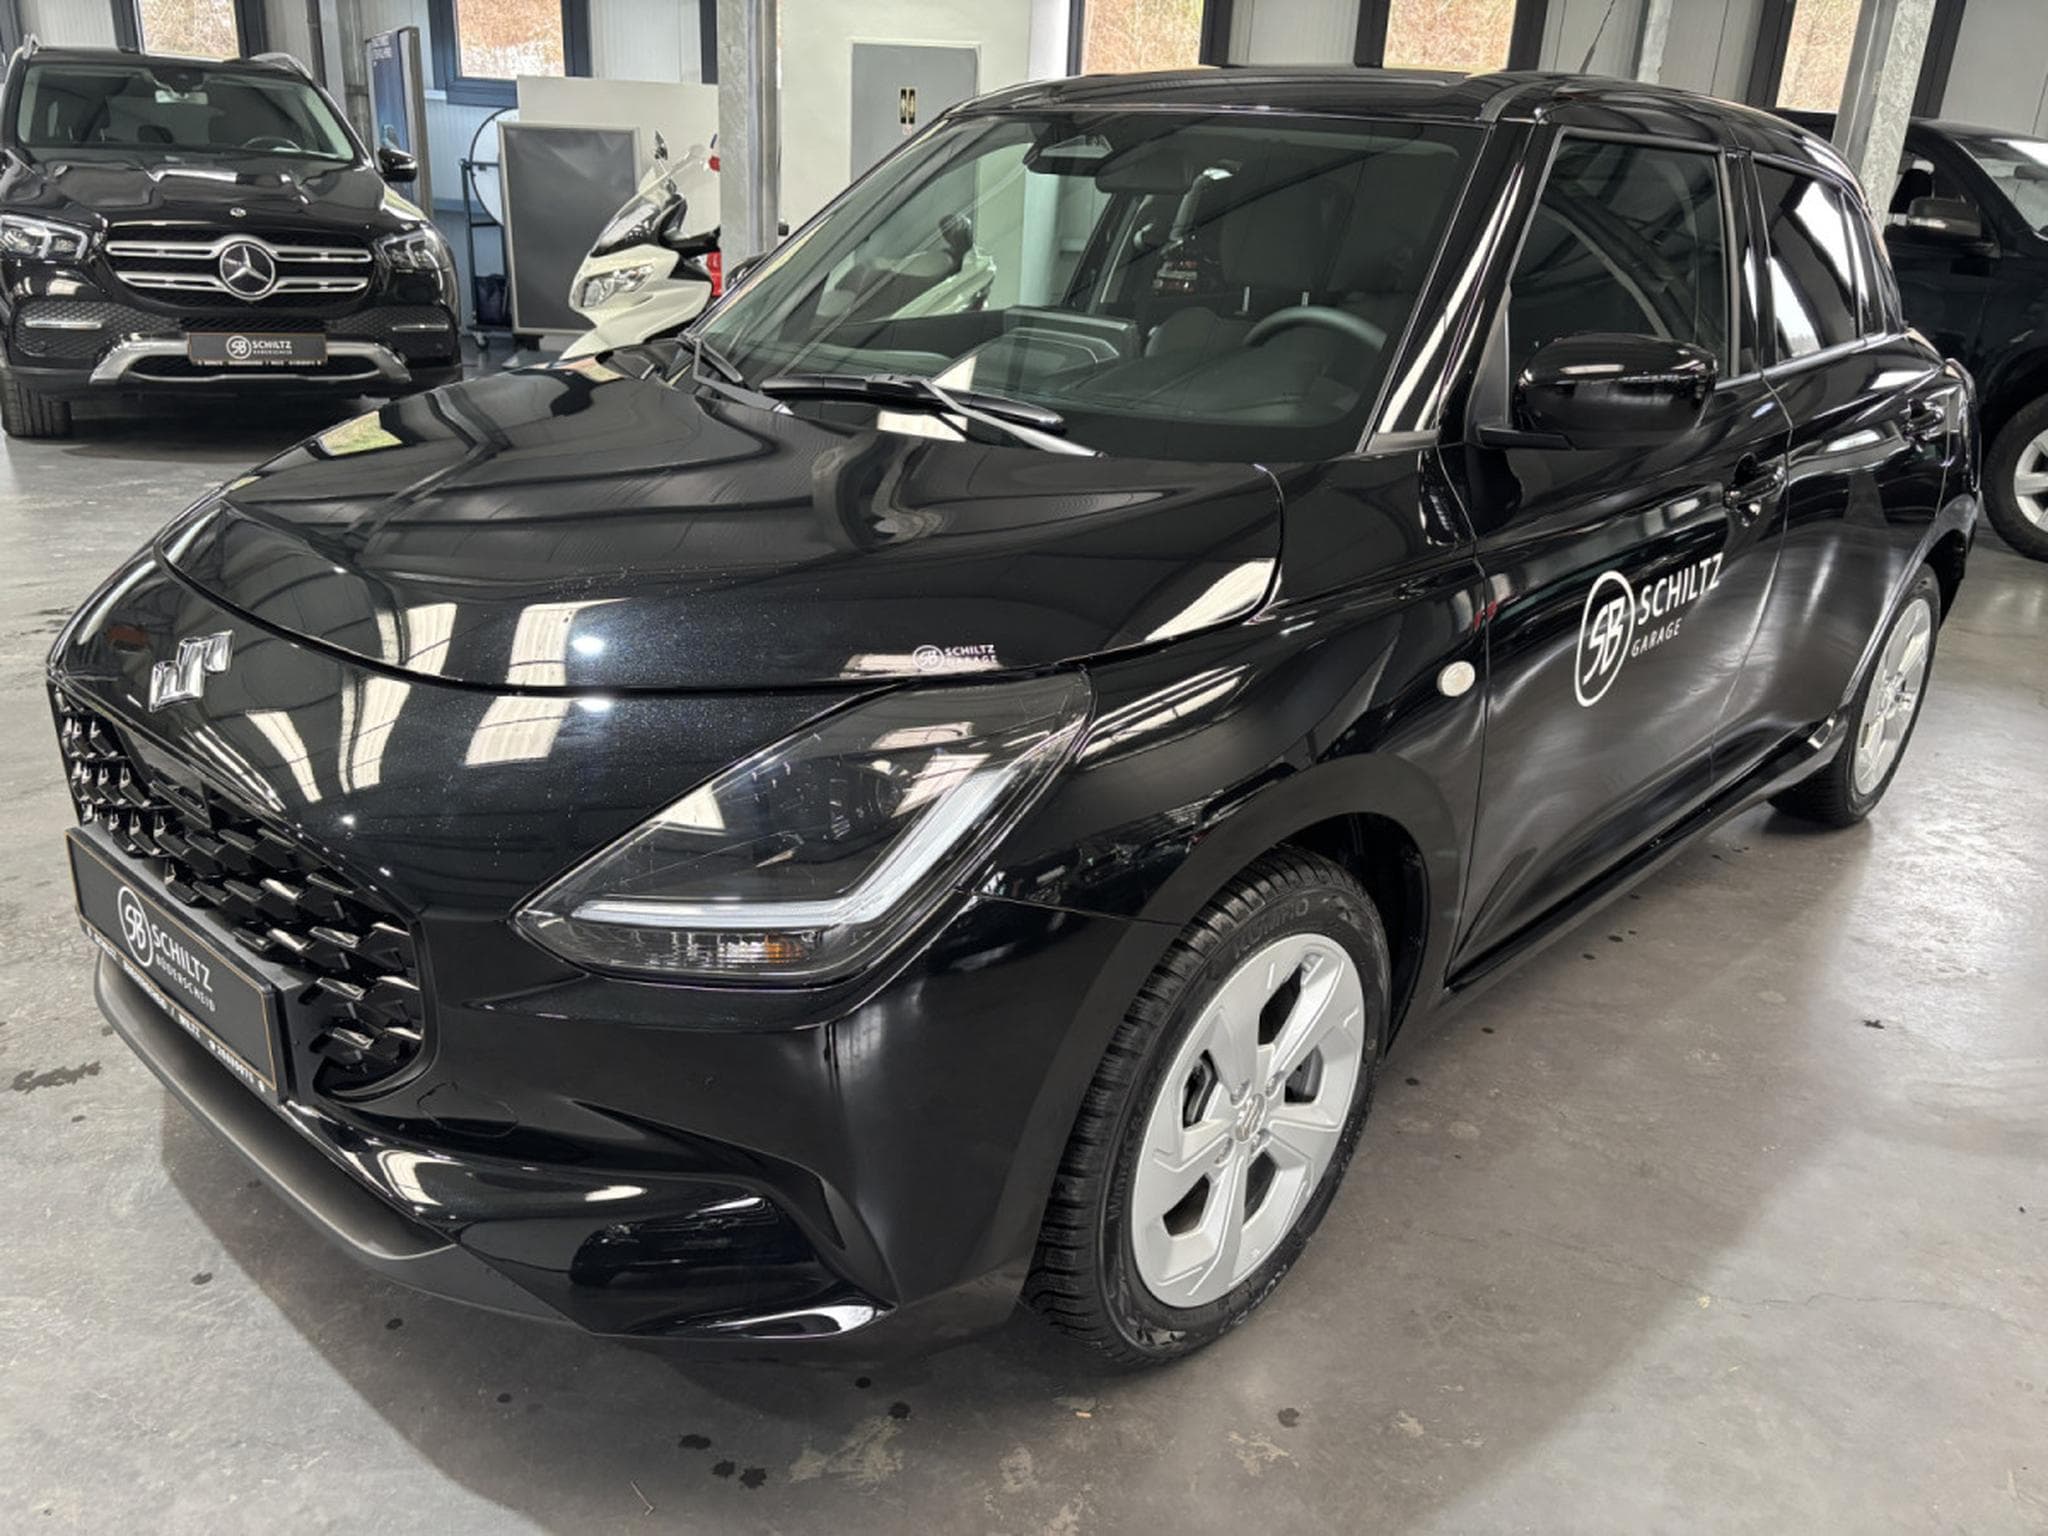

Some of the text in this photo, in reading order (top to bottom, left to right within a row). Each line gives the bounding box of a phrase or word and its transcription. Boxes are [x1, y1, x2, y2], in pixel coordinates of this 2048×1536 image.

[1637, 551, 1724, 625] SCHILTZ
[945, 645, 995, 657] SCHILTZ
[1630, 617, 1683, 657] GARAGE
[947, 655, 997, 665] GARAGE
[151, 923, 213, 992] SCHILTZ
